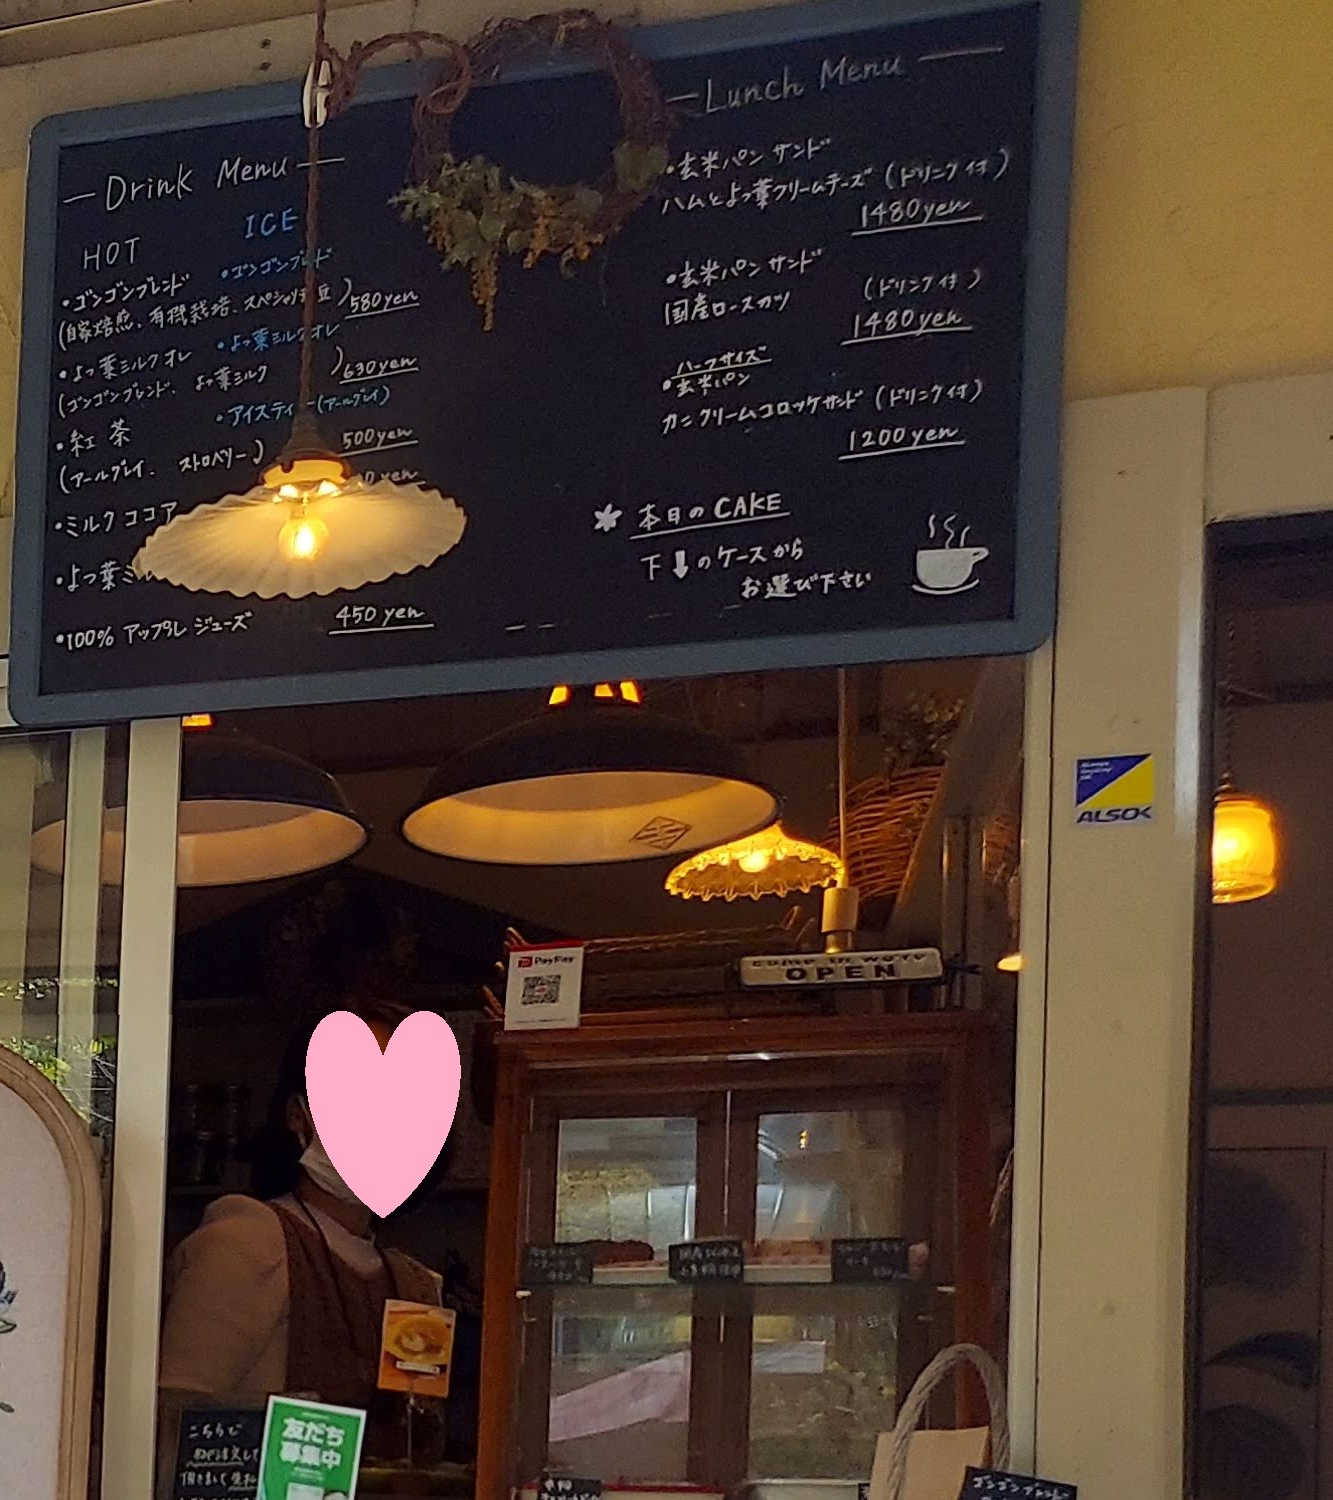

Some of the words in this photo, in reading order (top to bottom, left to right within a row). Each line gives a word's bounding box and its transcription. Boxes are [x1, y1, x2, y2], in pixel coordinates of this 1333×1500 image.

[706, 66, 805, 113] Lunch
[820, 51, 904, 91] Menu
[106, 164, 193, 211] Drink
[217, 156, 288, 188] Menu
[244, 208, 299, 239] ICE
[83, 237, 142, 271] HOT
[1077, 806, 1152, 824] ALSOK
[535, 954, 574, 967] PayPay
[785, 964, 896, 981] OPEN
[282, 1416, 345, 1448] 友だち
